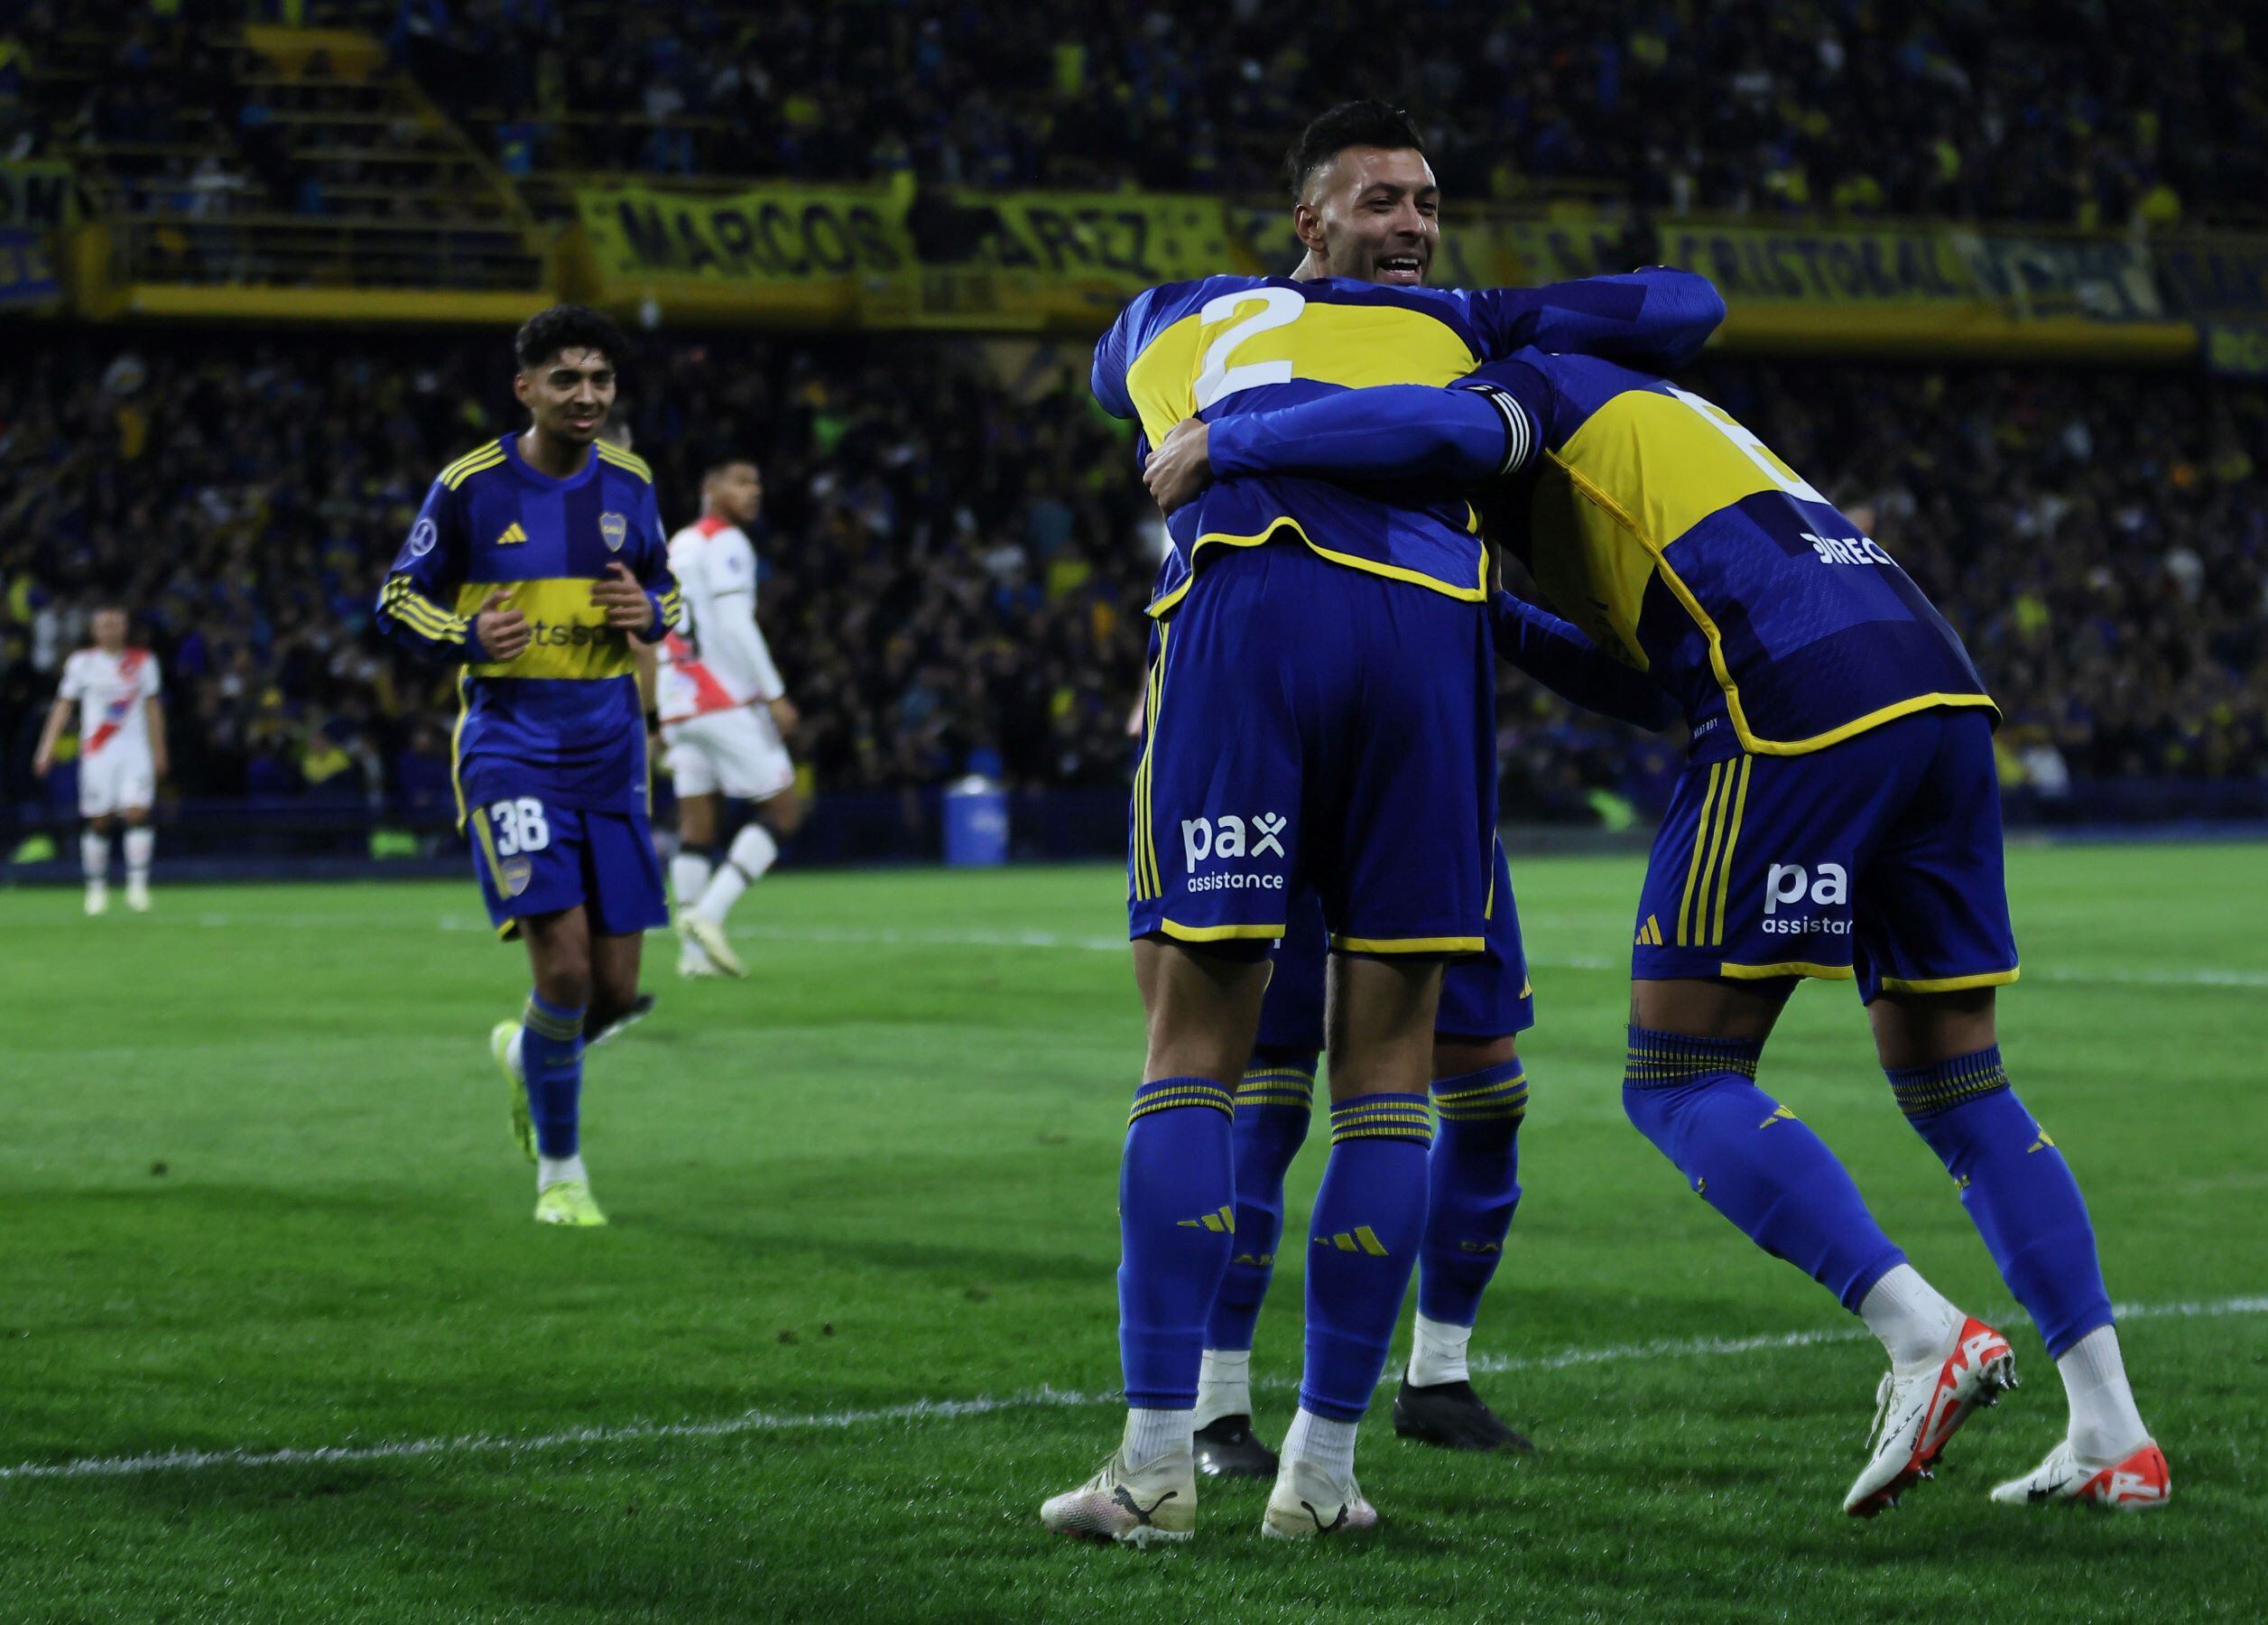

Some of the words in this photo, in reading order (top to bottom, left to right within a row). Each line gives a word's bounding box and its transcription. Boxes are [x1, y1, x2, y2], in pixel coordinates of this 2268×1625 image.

[619, 200, 901, 275] MARCOS
[1193, 286, 1306, 412] 2
[1800, 533, 1899, 566] DIREC
[1181, 812, 1288, 874] pax
[1188, 871, 1284, 893] assistance
[1763, 863, 1848, 915] pa
